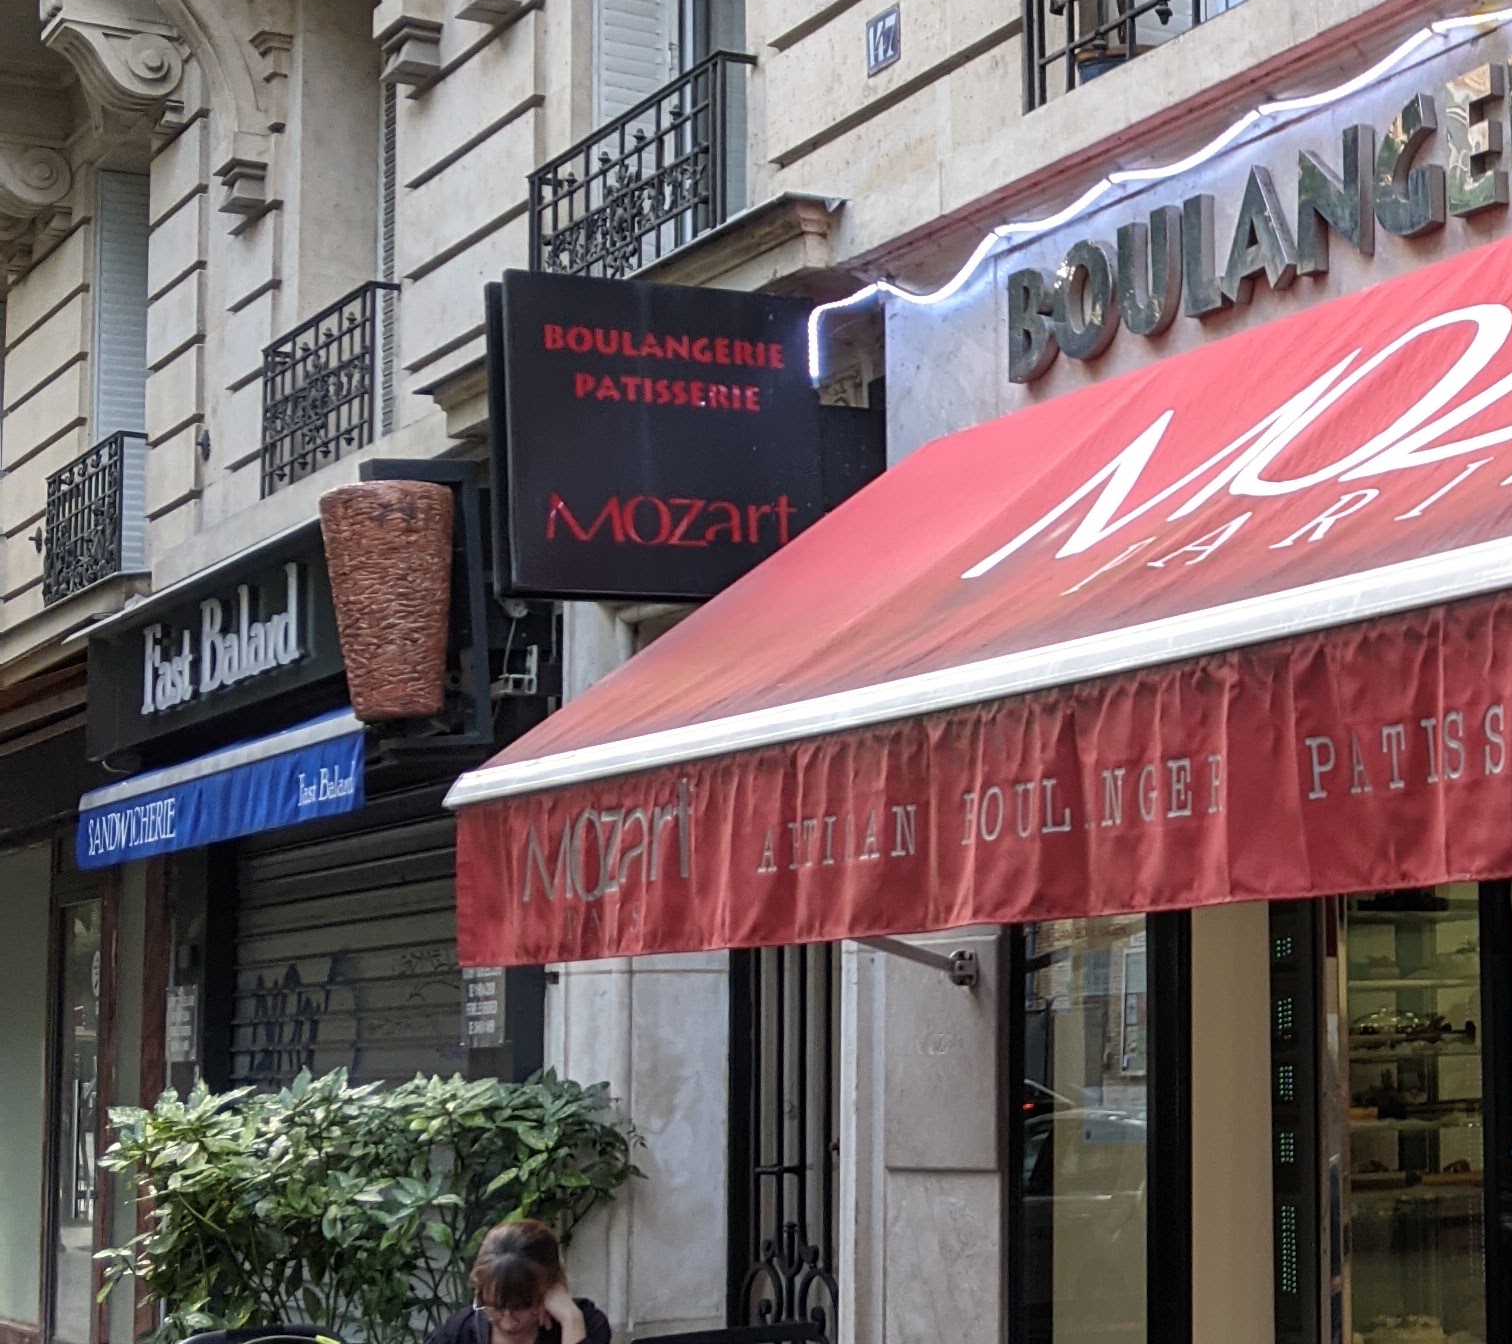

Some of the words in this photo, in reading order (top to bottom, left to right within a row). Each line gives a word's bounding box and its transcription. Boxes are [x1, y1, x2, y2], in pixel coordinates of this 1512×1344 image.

[869, 13, 897, 67] 147
[543, 323, 785, 369] BOULANGERIE
[574, 371, 761, 413] PATISSERIE
[141, 623, 192, 715] Fast
[199, 561, 303, 693] Balard
[88, 797, 176, 855] SANDWICHERIE
[961, 754, 1223, 846] OULNGE
